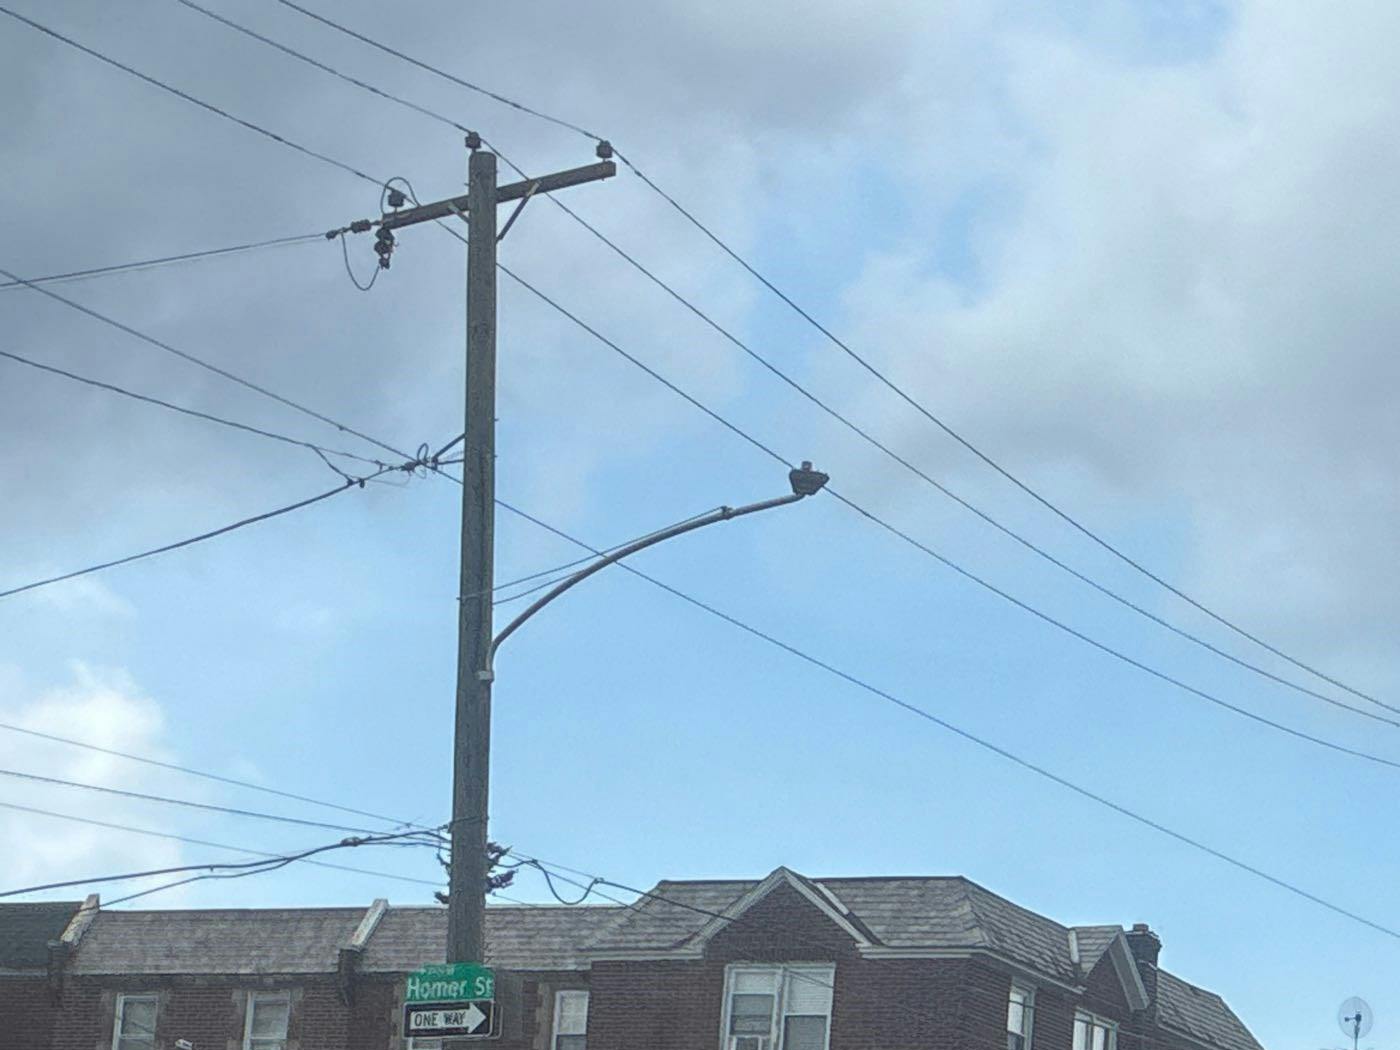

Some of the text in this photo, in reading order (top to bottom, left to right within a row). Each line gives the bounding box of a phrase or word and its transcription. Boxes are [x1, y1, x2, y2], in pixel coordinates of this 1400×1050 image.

[406, 976, 495, 999] Homer St
[414, 1011, 466, 1027] ONE WAY
